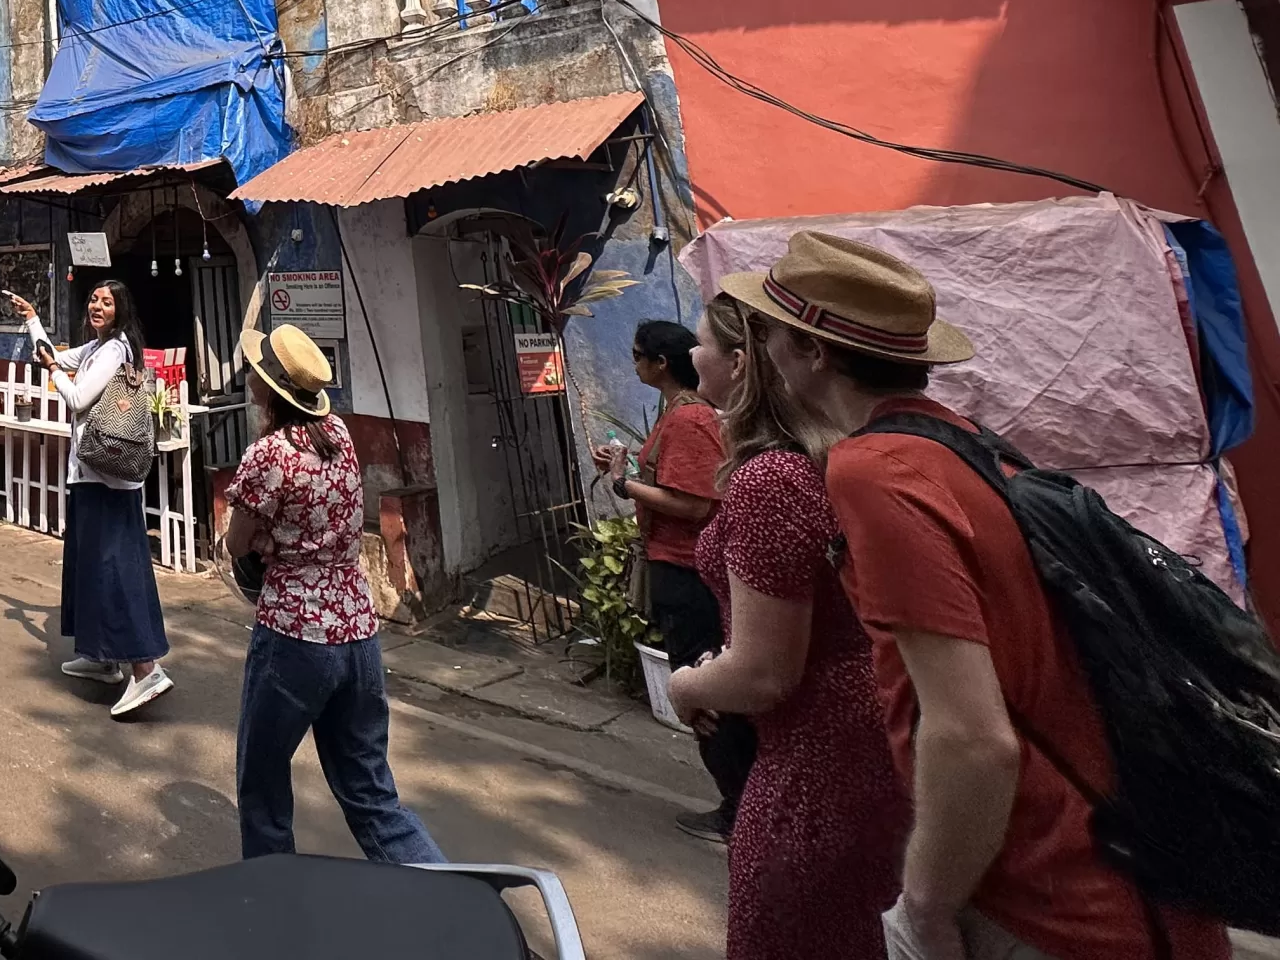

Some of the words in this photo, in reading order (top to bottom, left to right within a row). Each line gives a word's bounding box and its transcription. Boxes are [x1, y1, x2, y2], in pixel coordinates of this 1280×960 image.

[270, 274, 280, 282] NO
[282, 273, 317, 282] SMOKING
[319, 272, 340, 281] AREA
[519, 339, 529, 348] NO
[530, 339, 557, 348] PARKING
